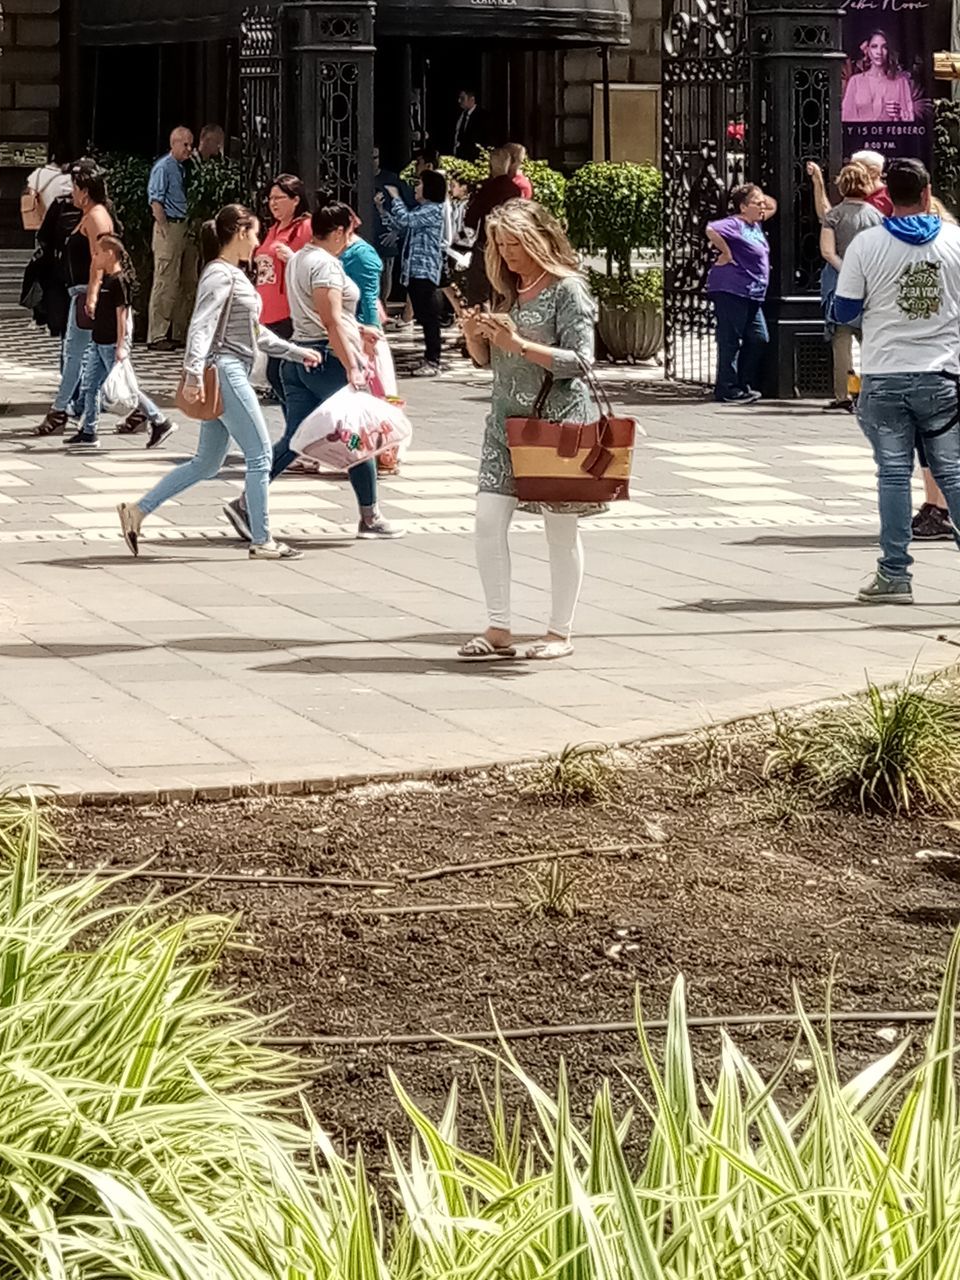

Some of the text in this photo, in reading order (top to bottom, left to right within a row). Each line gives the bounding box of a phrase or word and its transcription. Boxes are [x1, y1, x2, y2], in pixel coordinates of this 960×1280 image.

[847, 126, 853, 135] Y
[857, 126, 868, 135] 15
[871, 126, 883, 135] DE
[886, 126, 926, 135] FEBRERO
